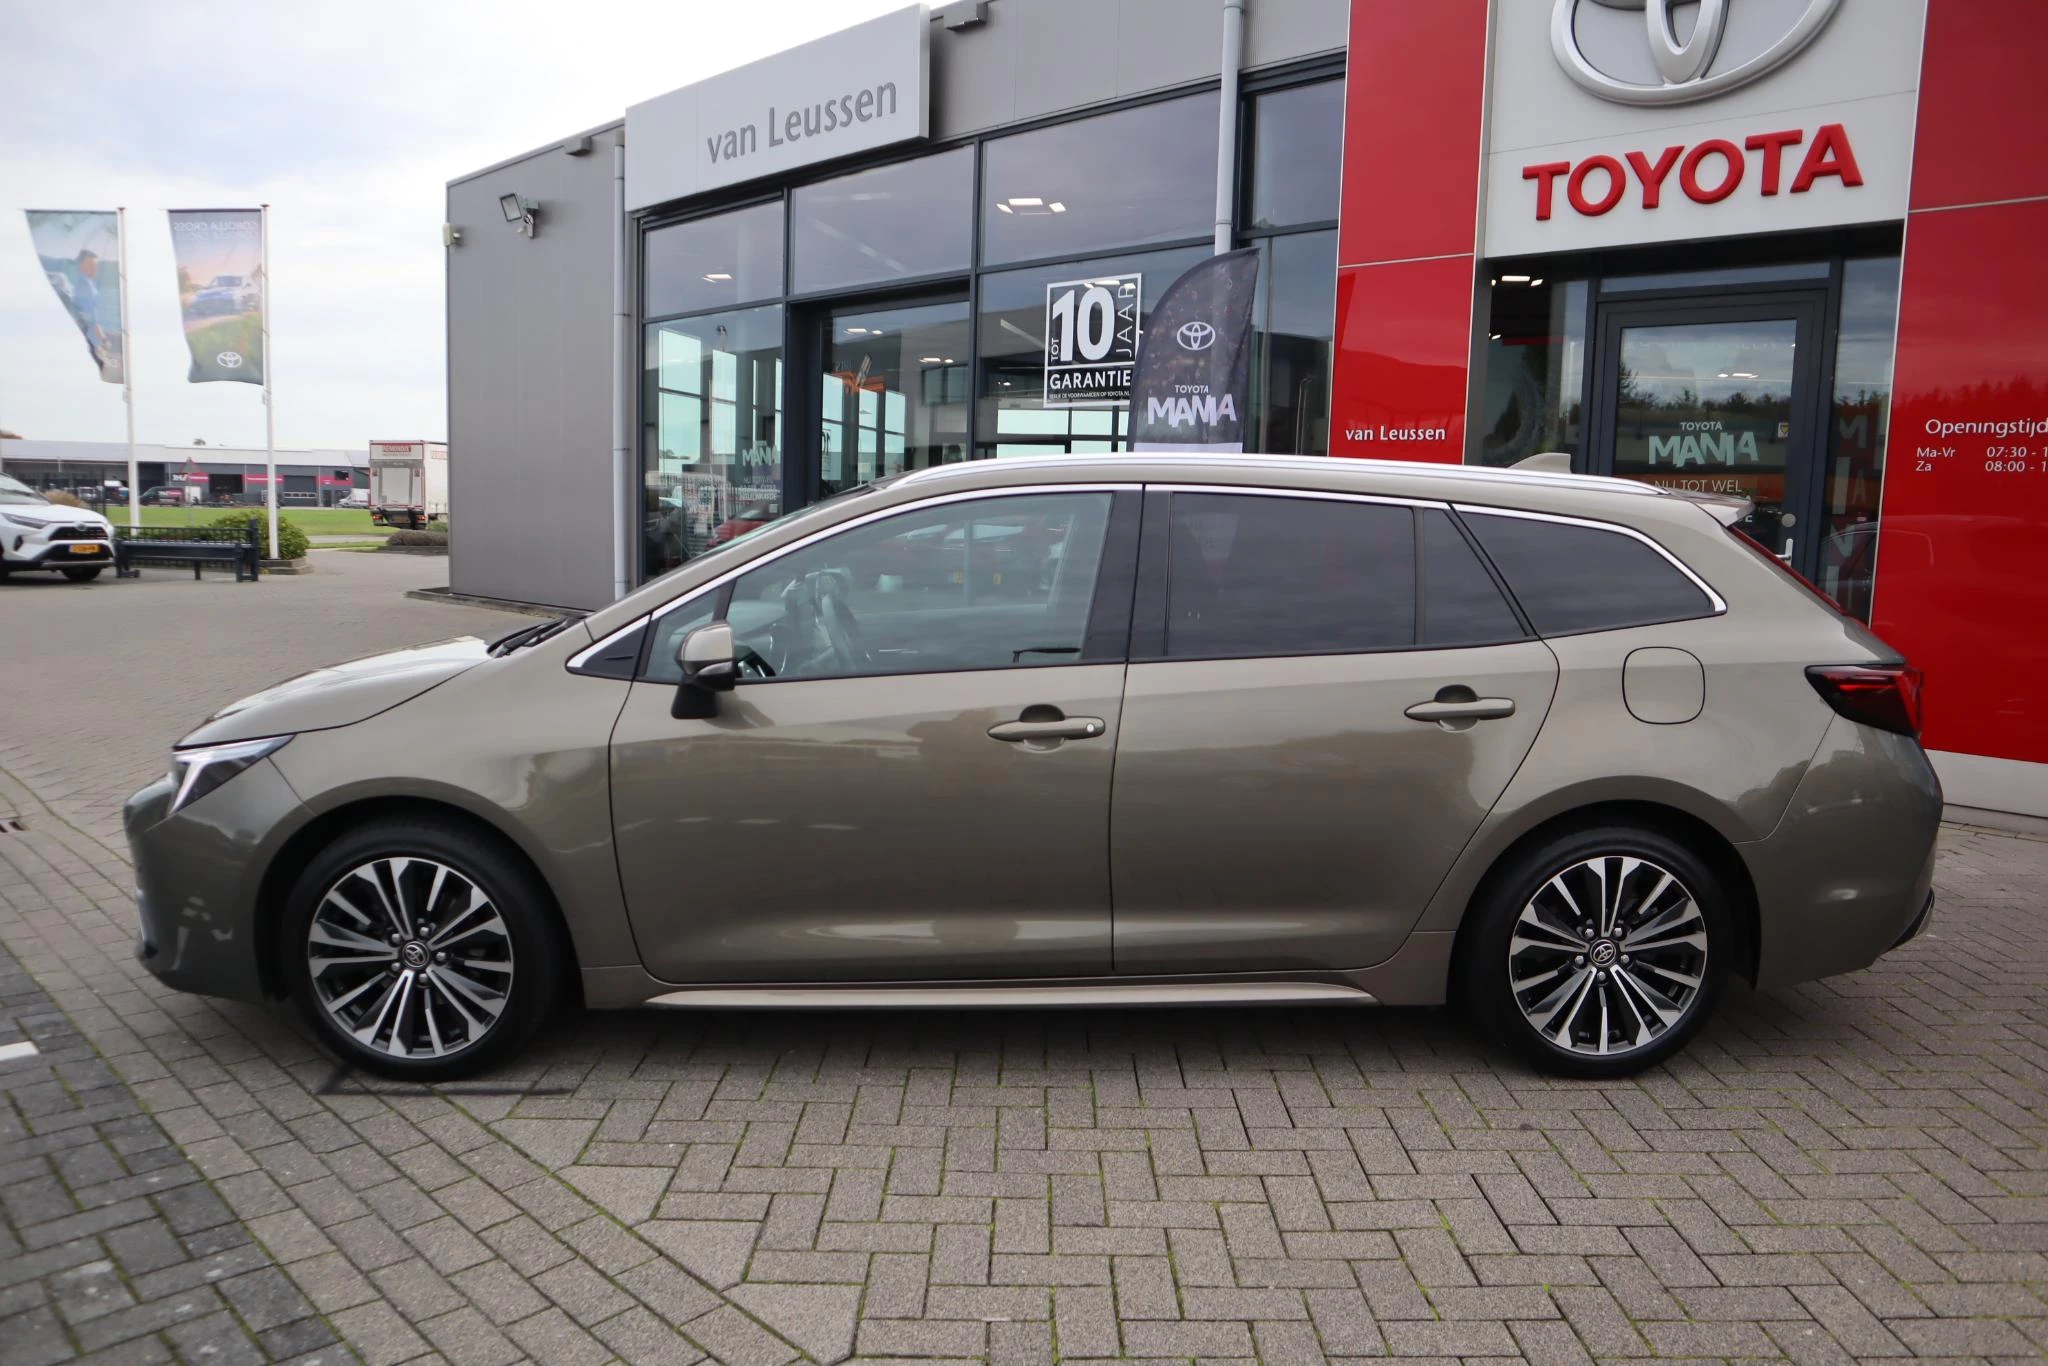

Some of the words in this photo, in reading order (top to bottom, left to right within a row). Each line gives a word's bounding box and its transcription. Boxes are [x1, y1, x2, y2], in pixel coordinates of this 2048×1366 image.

[706, 123, 757, 165] van
[768, 81, 898, 149] Leussen
[1522, 123, 1864, 221] TOYOTA
[1052, 286, 1115, 362] 10
[1116, 282, 1135, 358] JAAR
[1049, 337, 1060, 361] TOT
[1050, 370, 1131, 389] GARANTIE
[1175, 384, 1209, 393] TOYOTA
[1147, 393, 1238, 428] MANIA
[1345, 428, 1374, 441] van
[1380, 425, 1446, 441] Leussen
[1680, 421, 1723, 432] TOYOTA
[1648, 431, 1760, 468] MANIA
[1916, 447, 1956, 458] Ma-Vr
[1986, 446, 2027, 458] 07:30
[1915, 460, 1932, 472] Za
[1985, 460, 2026, 472] 08:00
[1680, 480, 1708, 494] TOT
[1711, 480, 1743, 494] WEL
